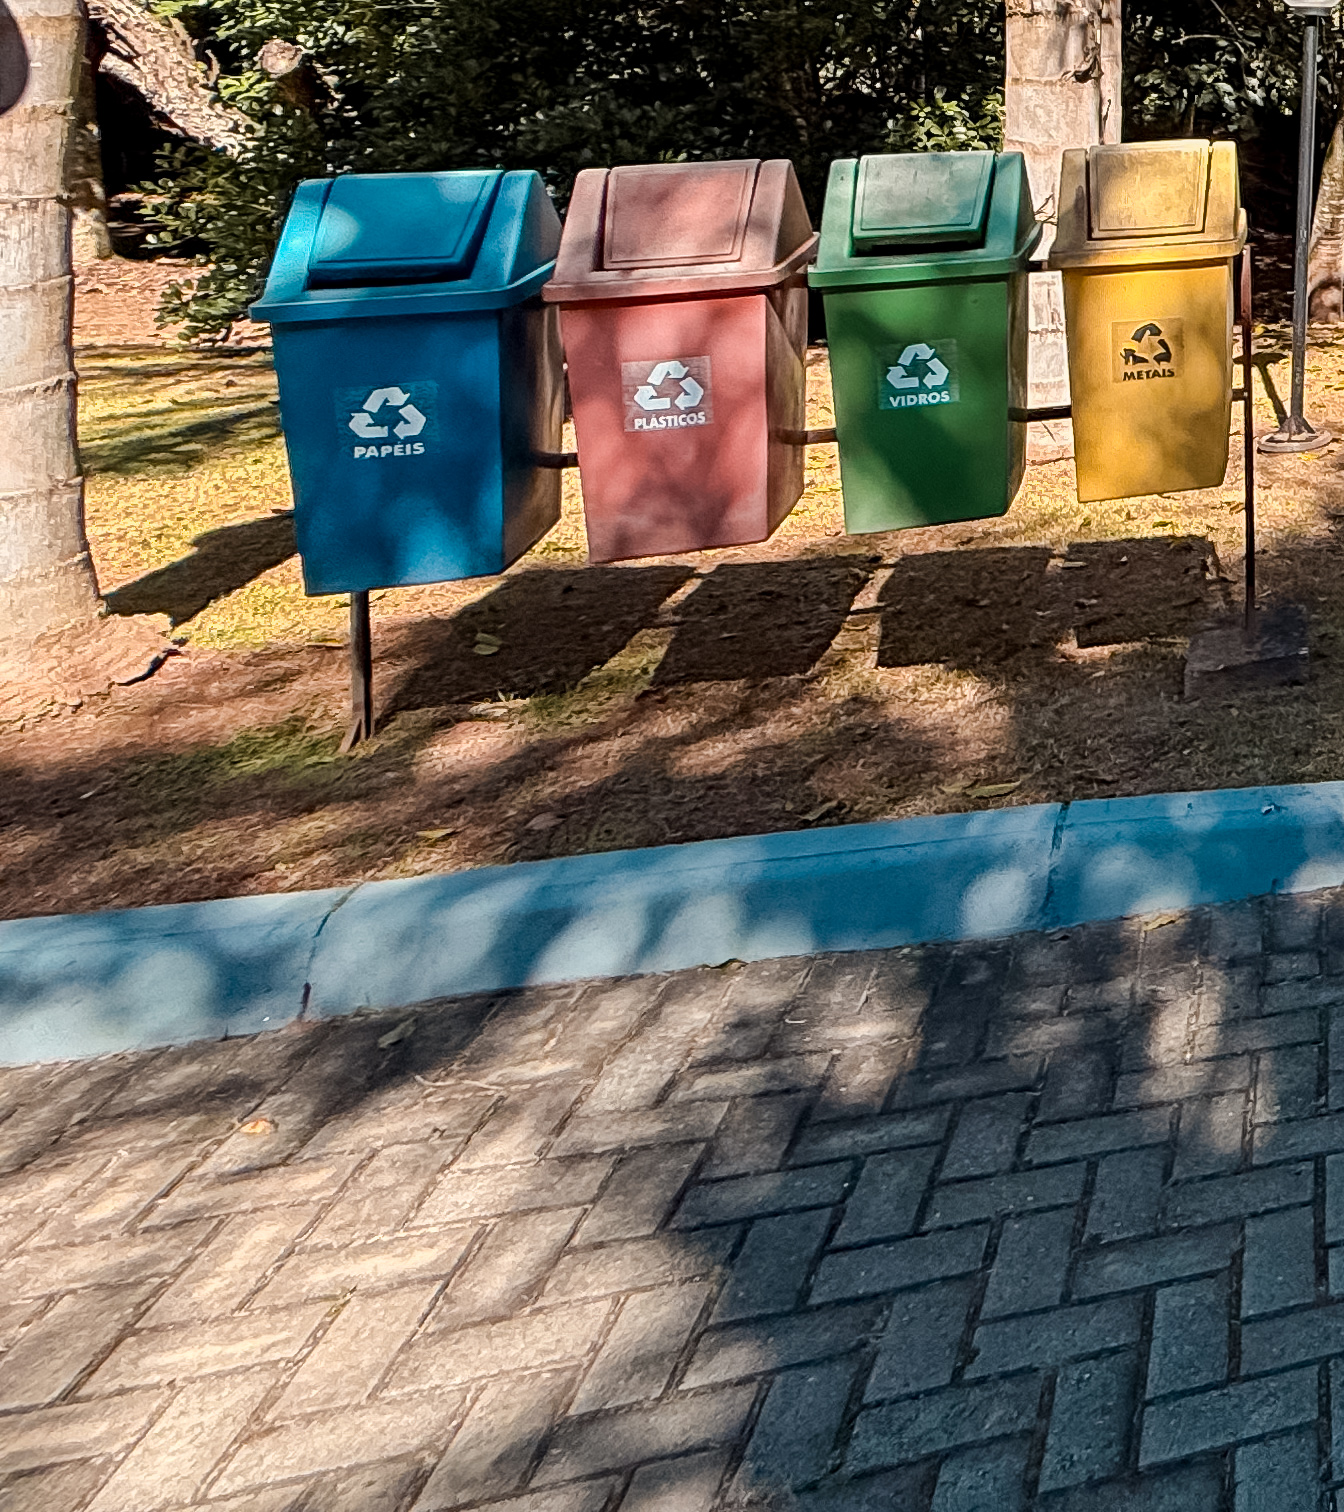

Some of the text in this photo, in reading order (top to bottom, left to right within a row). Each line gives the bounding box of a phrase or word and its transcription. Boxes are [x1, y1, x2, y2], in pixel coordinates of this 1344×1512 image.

[1122, 368, 1175, 381] METAIS
[889, 391, 950, 407] VIDROS
[634, 411, 705, 430] PLÁSTICOS
[353, 441, 425, 459] PAPÉIS
